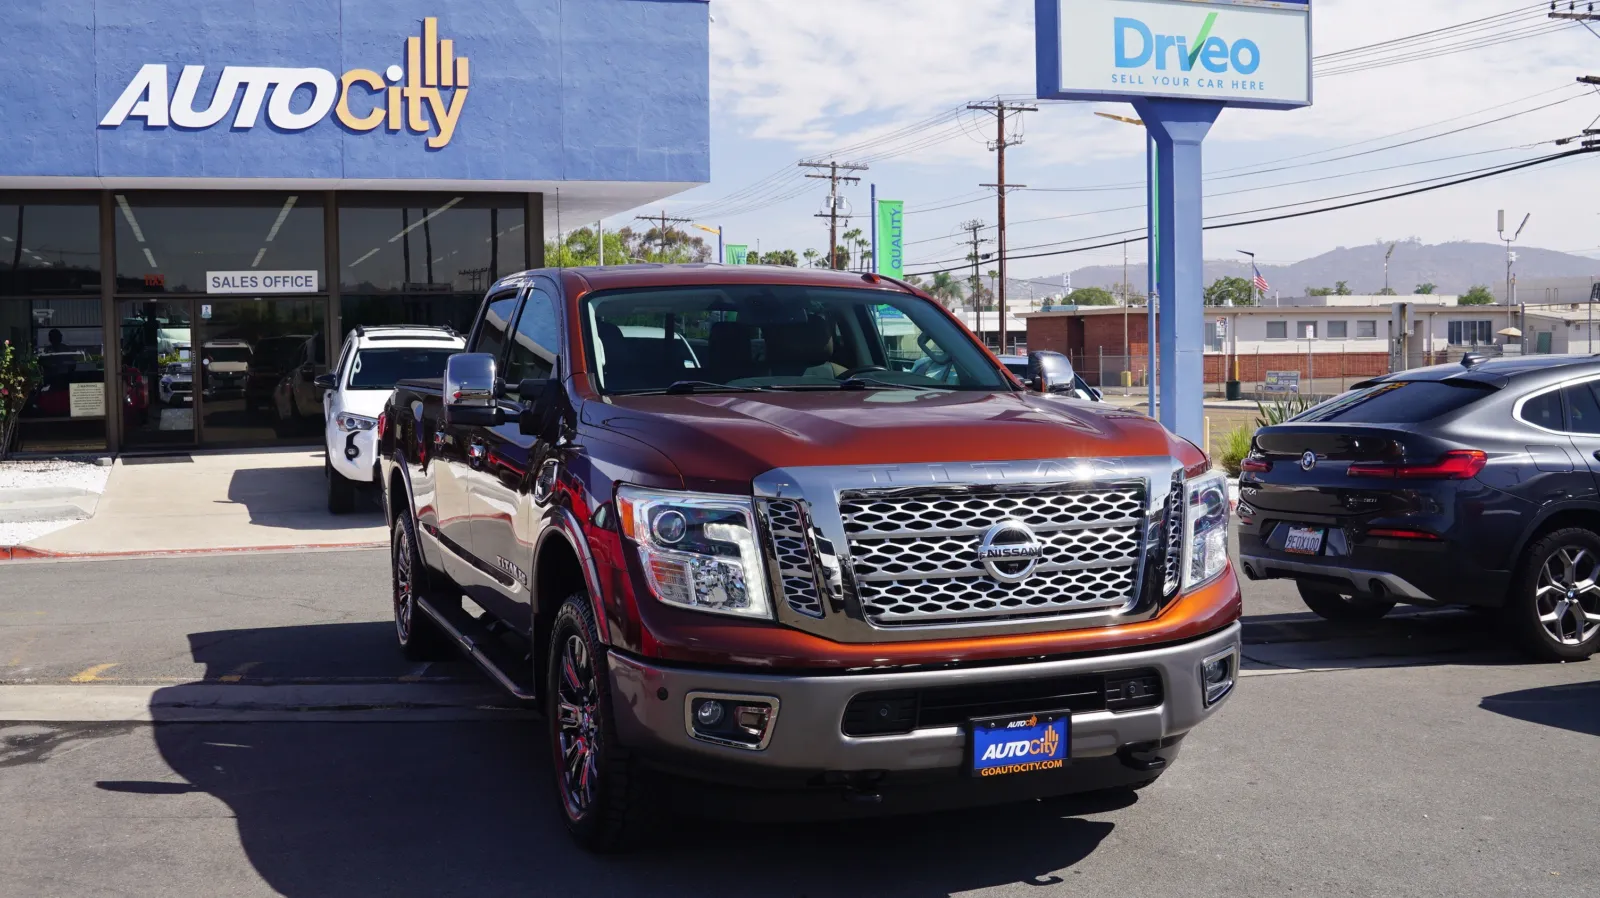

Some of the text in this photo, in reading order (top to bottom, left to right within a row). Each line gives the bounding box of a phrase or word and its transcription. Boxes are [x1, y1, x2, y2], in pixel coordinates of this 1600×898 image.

[1113, 12, 1261, 75] Driveo
[99, 17, 469, 148] AUTOCity
[1111, 74, 1265, 91] SELL YOUR CAR HERE
[212, 275, 313, 288] SALES OFFICE
[986, 547, 1037, 558] NISSAN
[1007, 714, 1038, 728] AUTOCity
[981, 725, 1059, 761] AUTOCity
[981, 760, 1063, 777] GOAUTOCITY.COM
